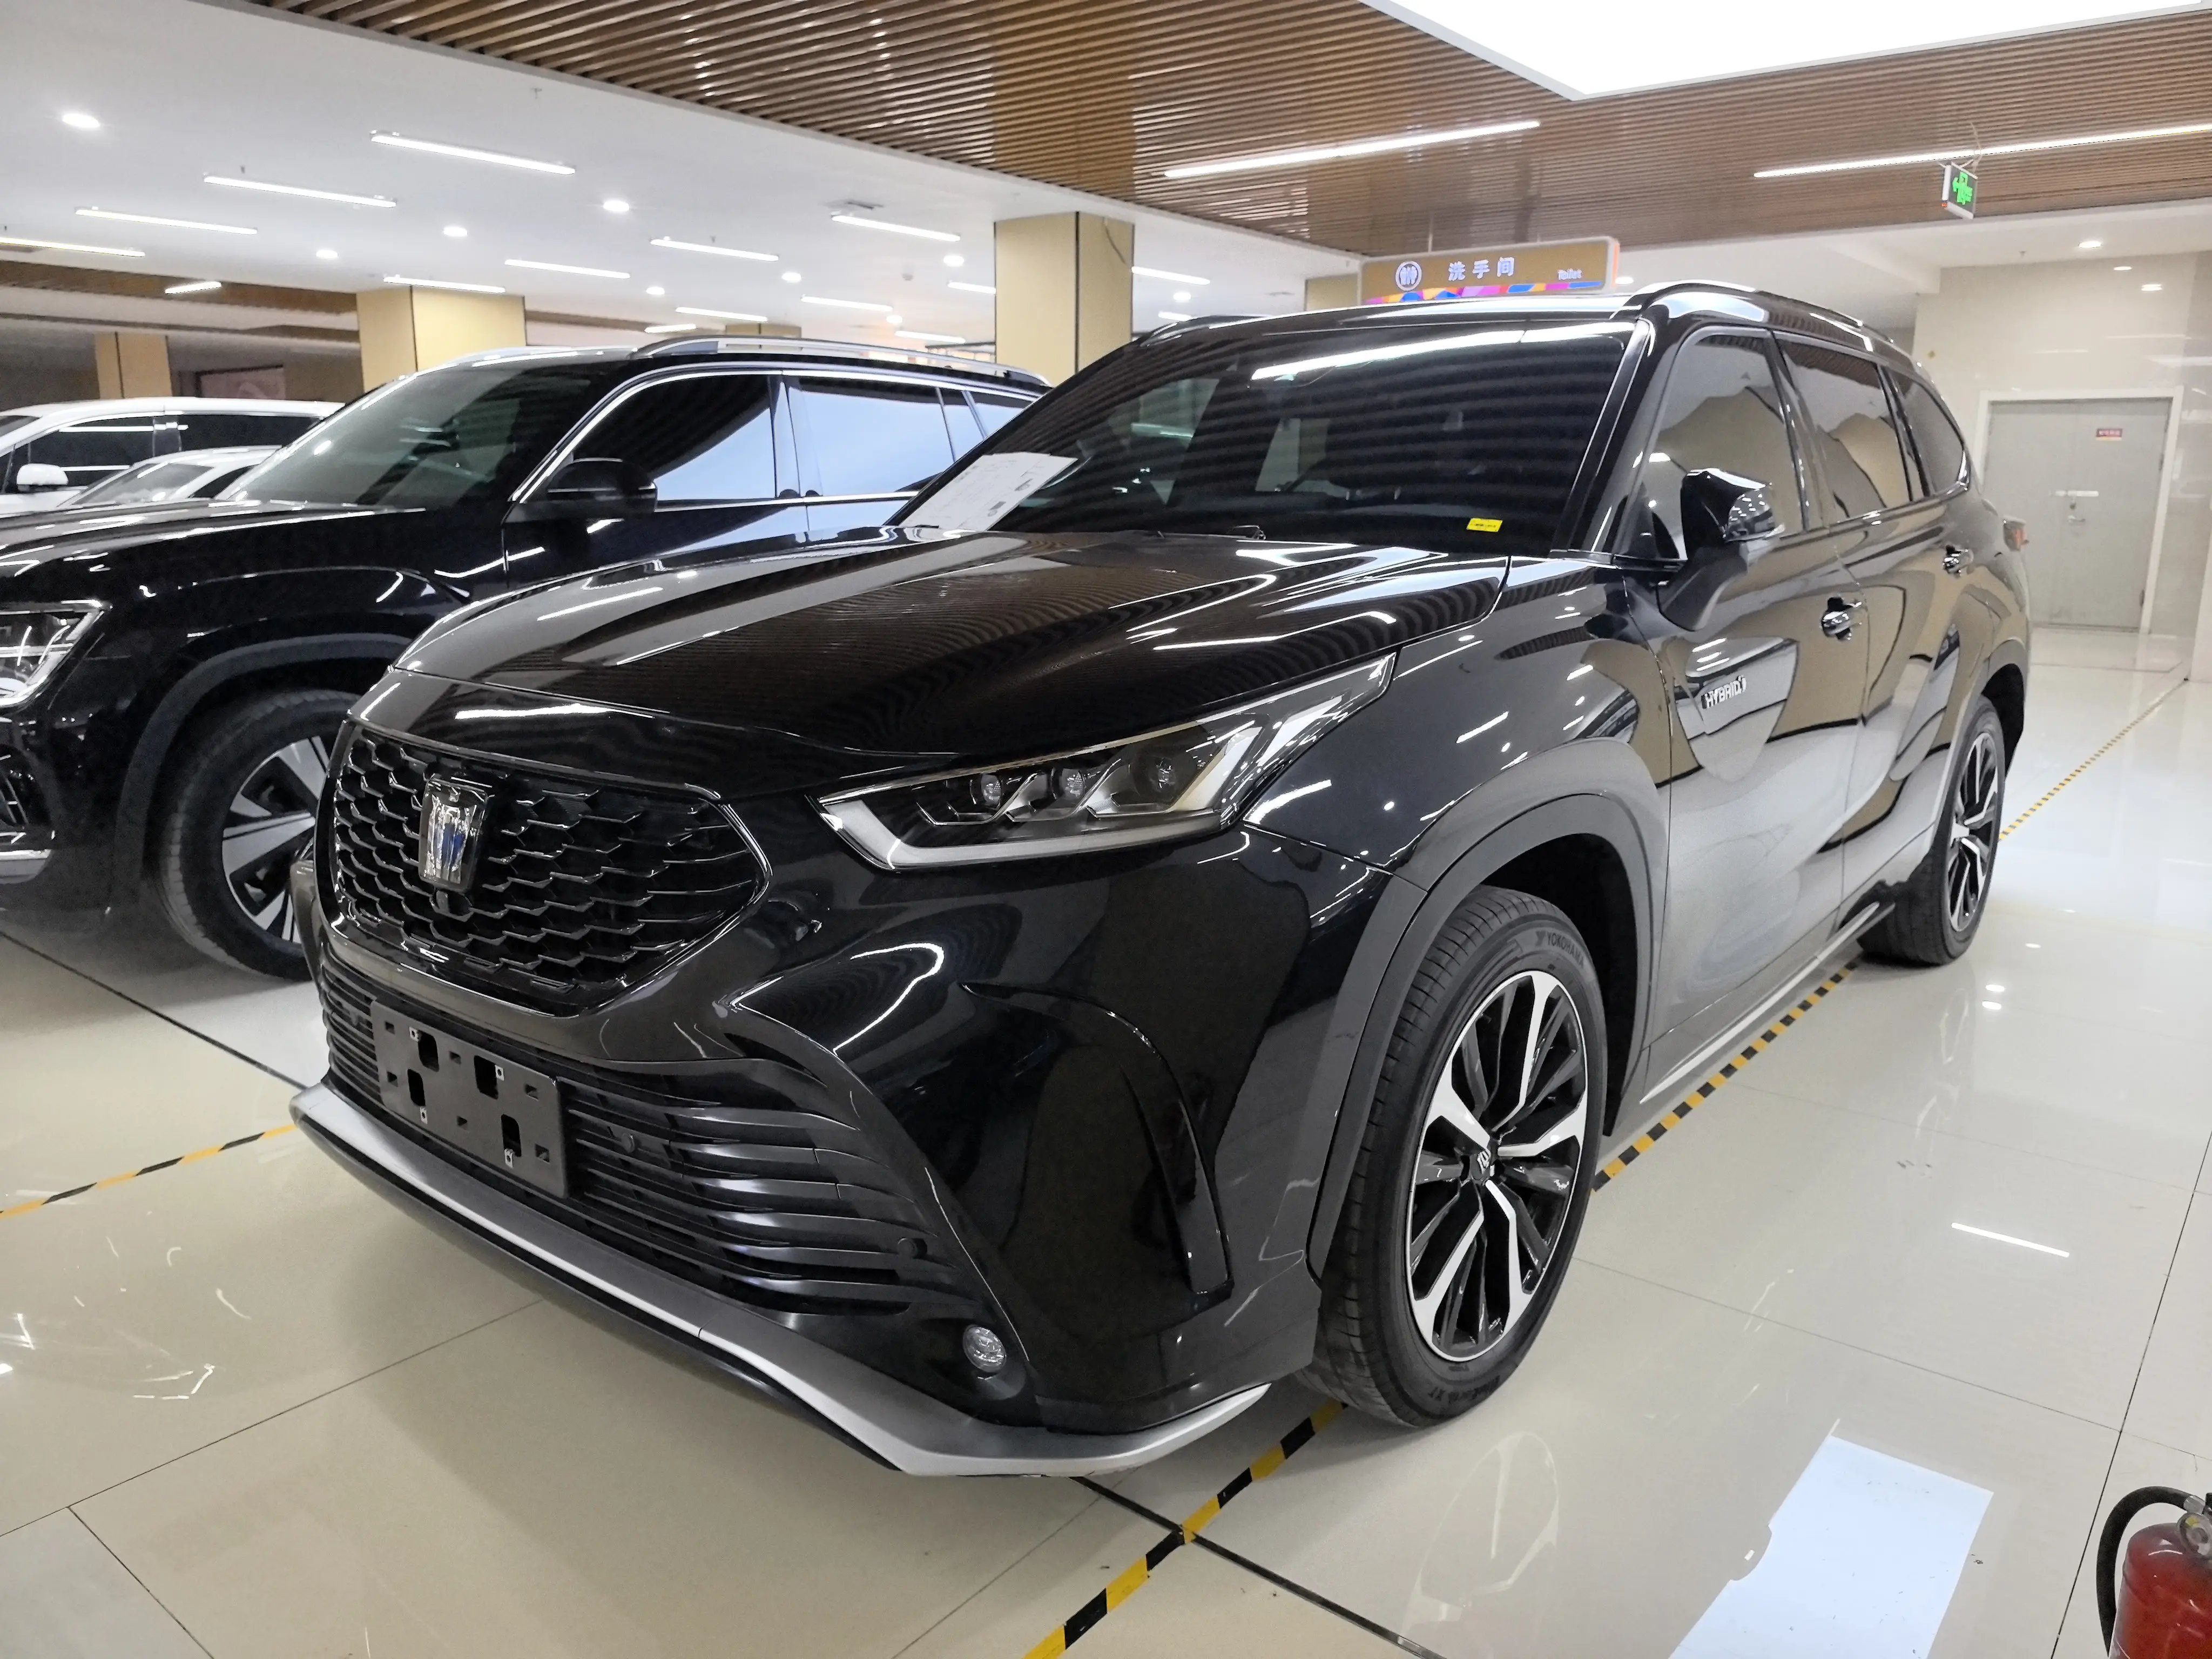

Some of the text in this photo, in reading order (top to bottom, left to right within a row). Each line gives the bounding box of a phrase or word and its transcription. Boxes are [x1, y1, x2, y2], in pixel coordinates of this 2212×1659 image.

[1448, 257, 1515, 281] 洗手间
[1704, 680, 1742, 709] HYBRID
[1547, 931, 1584, 969] YOKOHAMA
